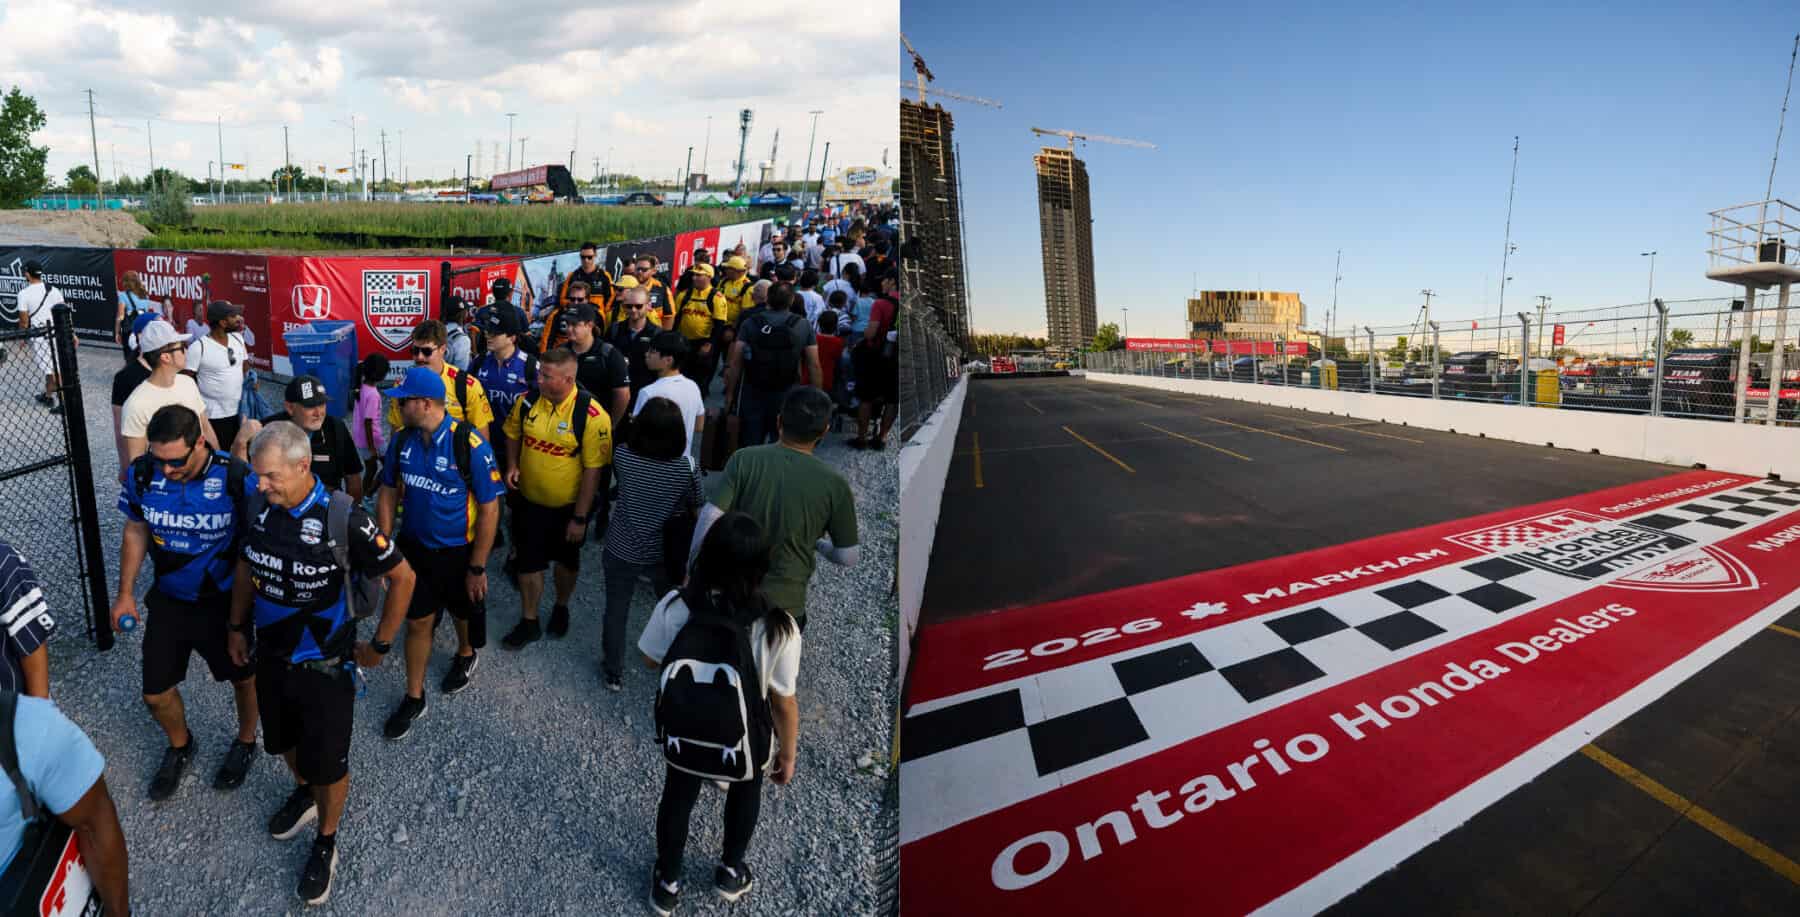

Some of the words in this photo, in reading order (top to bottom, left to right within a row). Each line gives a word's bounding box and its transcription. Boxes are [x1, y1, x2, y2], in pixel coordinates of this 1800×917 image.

[146, 255, 172, 273] CITY
[175, 256, 188, 274] OF
[41, 273, 103, 287] RESIDENTIAL
[137, 272, 203, 300] HAMPIONS
[61, 288, 107, 301] MERCIAL
[371, 295, 422, 306] Honda
[378, 316, 415, 326] INDY
[141, 504, 232, 530] SiriusXM
[1525, 526, 1599, 548] ONTARIO
[1526, 528, 1638, 561] Honda
[1552, 532, 1662, 568] DEALERS
[1601, 541, 1673, 569] INDY
[983, 617, 1163, 671] 2026
[1242, 548, 1448, 604] MARKHAM
[990, 732, 1330, 891] Ontario
[1330, 655, 1512, 741] Honda
[1499, 600, 1637, 665] Dealers
